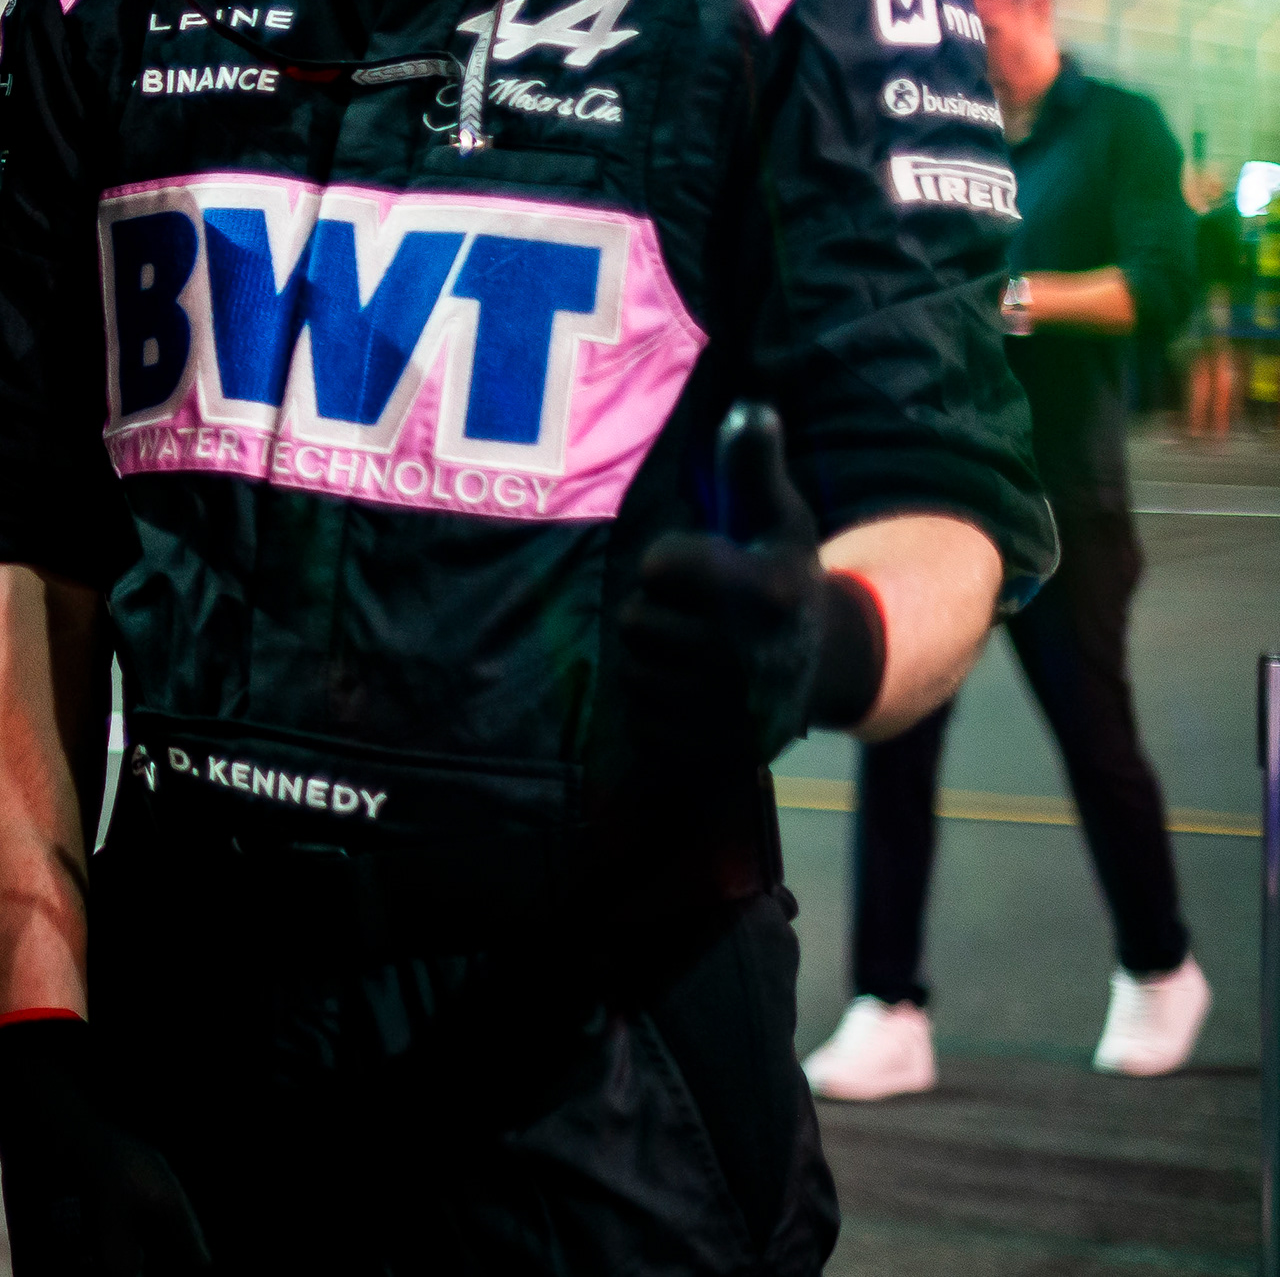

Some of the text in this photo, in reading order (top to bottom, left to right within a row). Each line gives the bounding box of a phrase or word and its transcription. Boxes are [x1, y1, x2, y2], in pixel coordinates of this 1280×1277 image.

[149, 8, 294, 32] LPINE
[142, 66, 281, 94] BINANCE
[111, 206, 603, 447] BWT
[139, 426, 240, 462] WATER
[255, 430, 559, 514] TECHNOLOGY
[167, 746, 388, 820] D. KENNEDY
